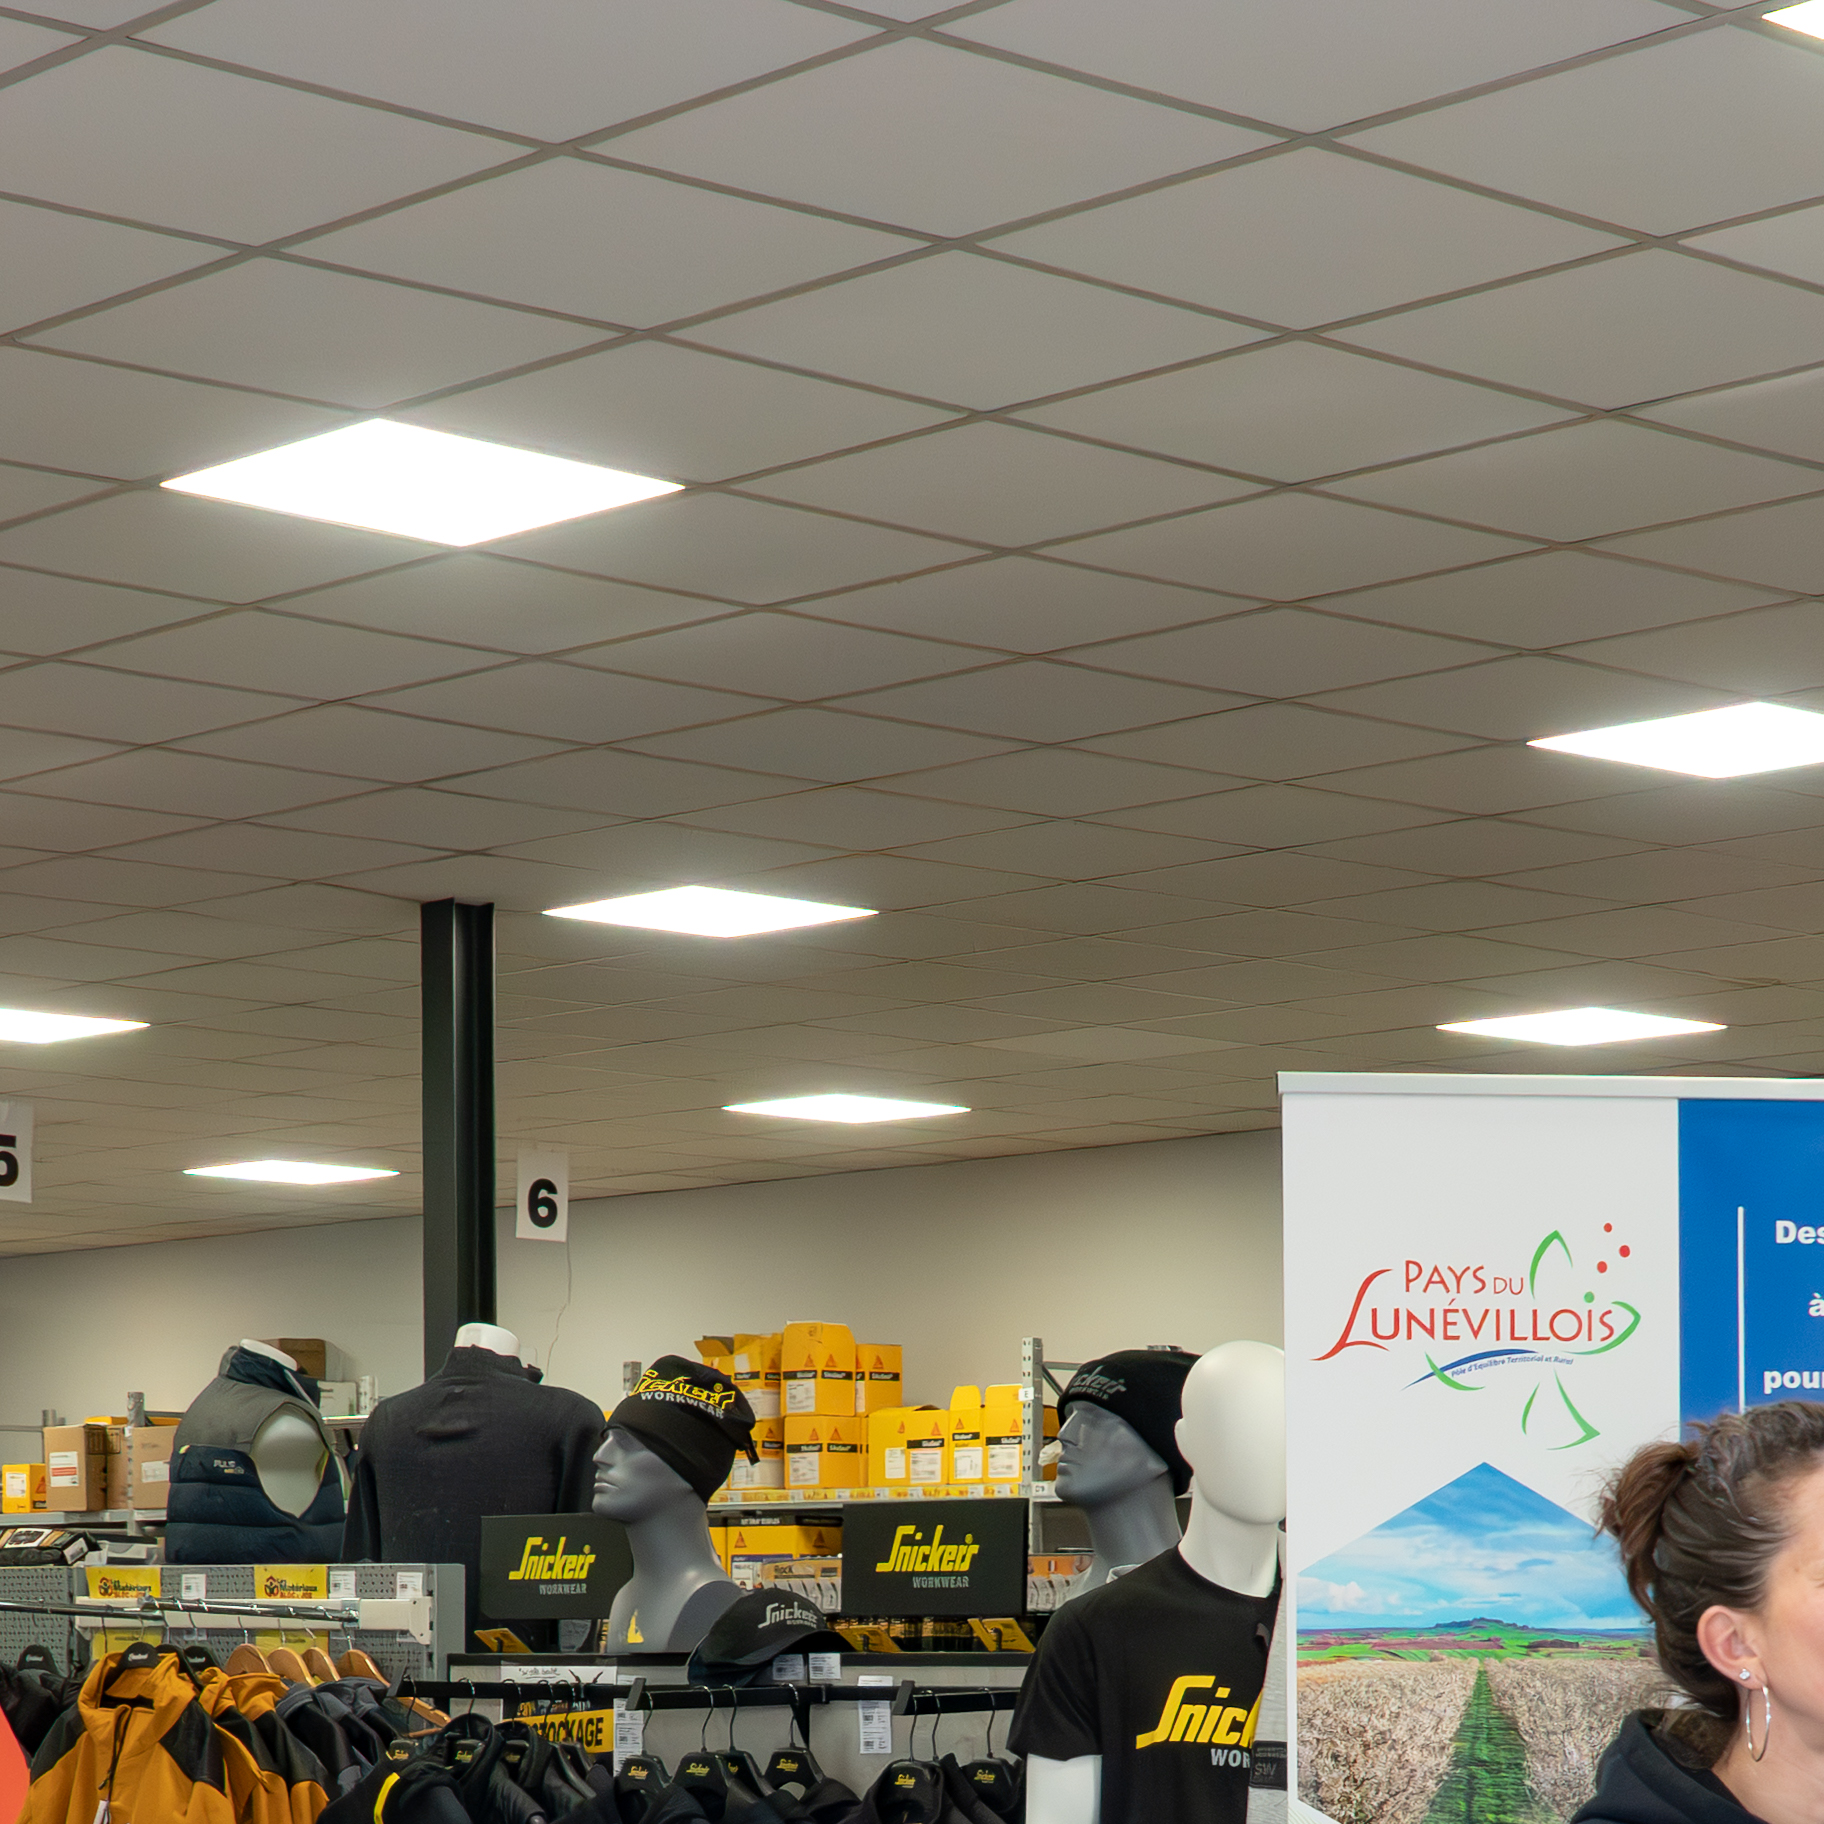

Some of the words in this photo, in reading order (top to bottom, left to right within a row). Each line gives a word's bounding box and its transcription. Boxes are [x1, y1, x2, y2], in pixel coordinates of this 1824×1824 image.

[528, 1178, 559, 1229] 6
[640, 1391, 725, 1419] WORKWEAR
[508, 1536, 596, 1582] Snickers
[876, 1524, 980, 1573] Snickers
[539, 1582, 587, 1595] WORKWEAR
[912, 1575, 969, 1588] WORKWEAR
